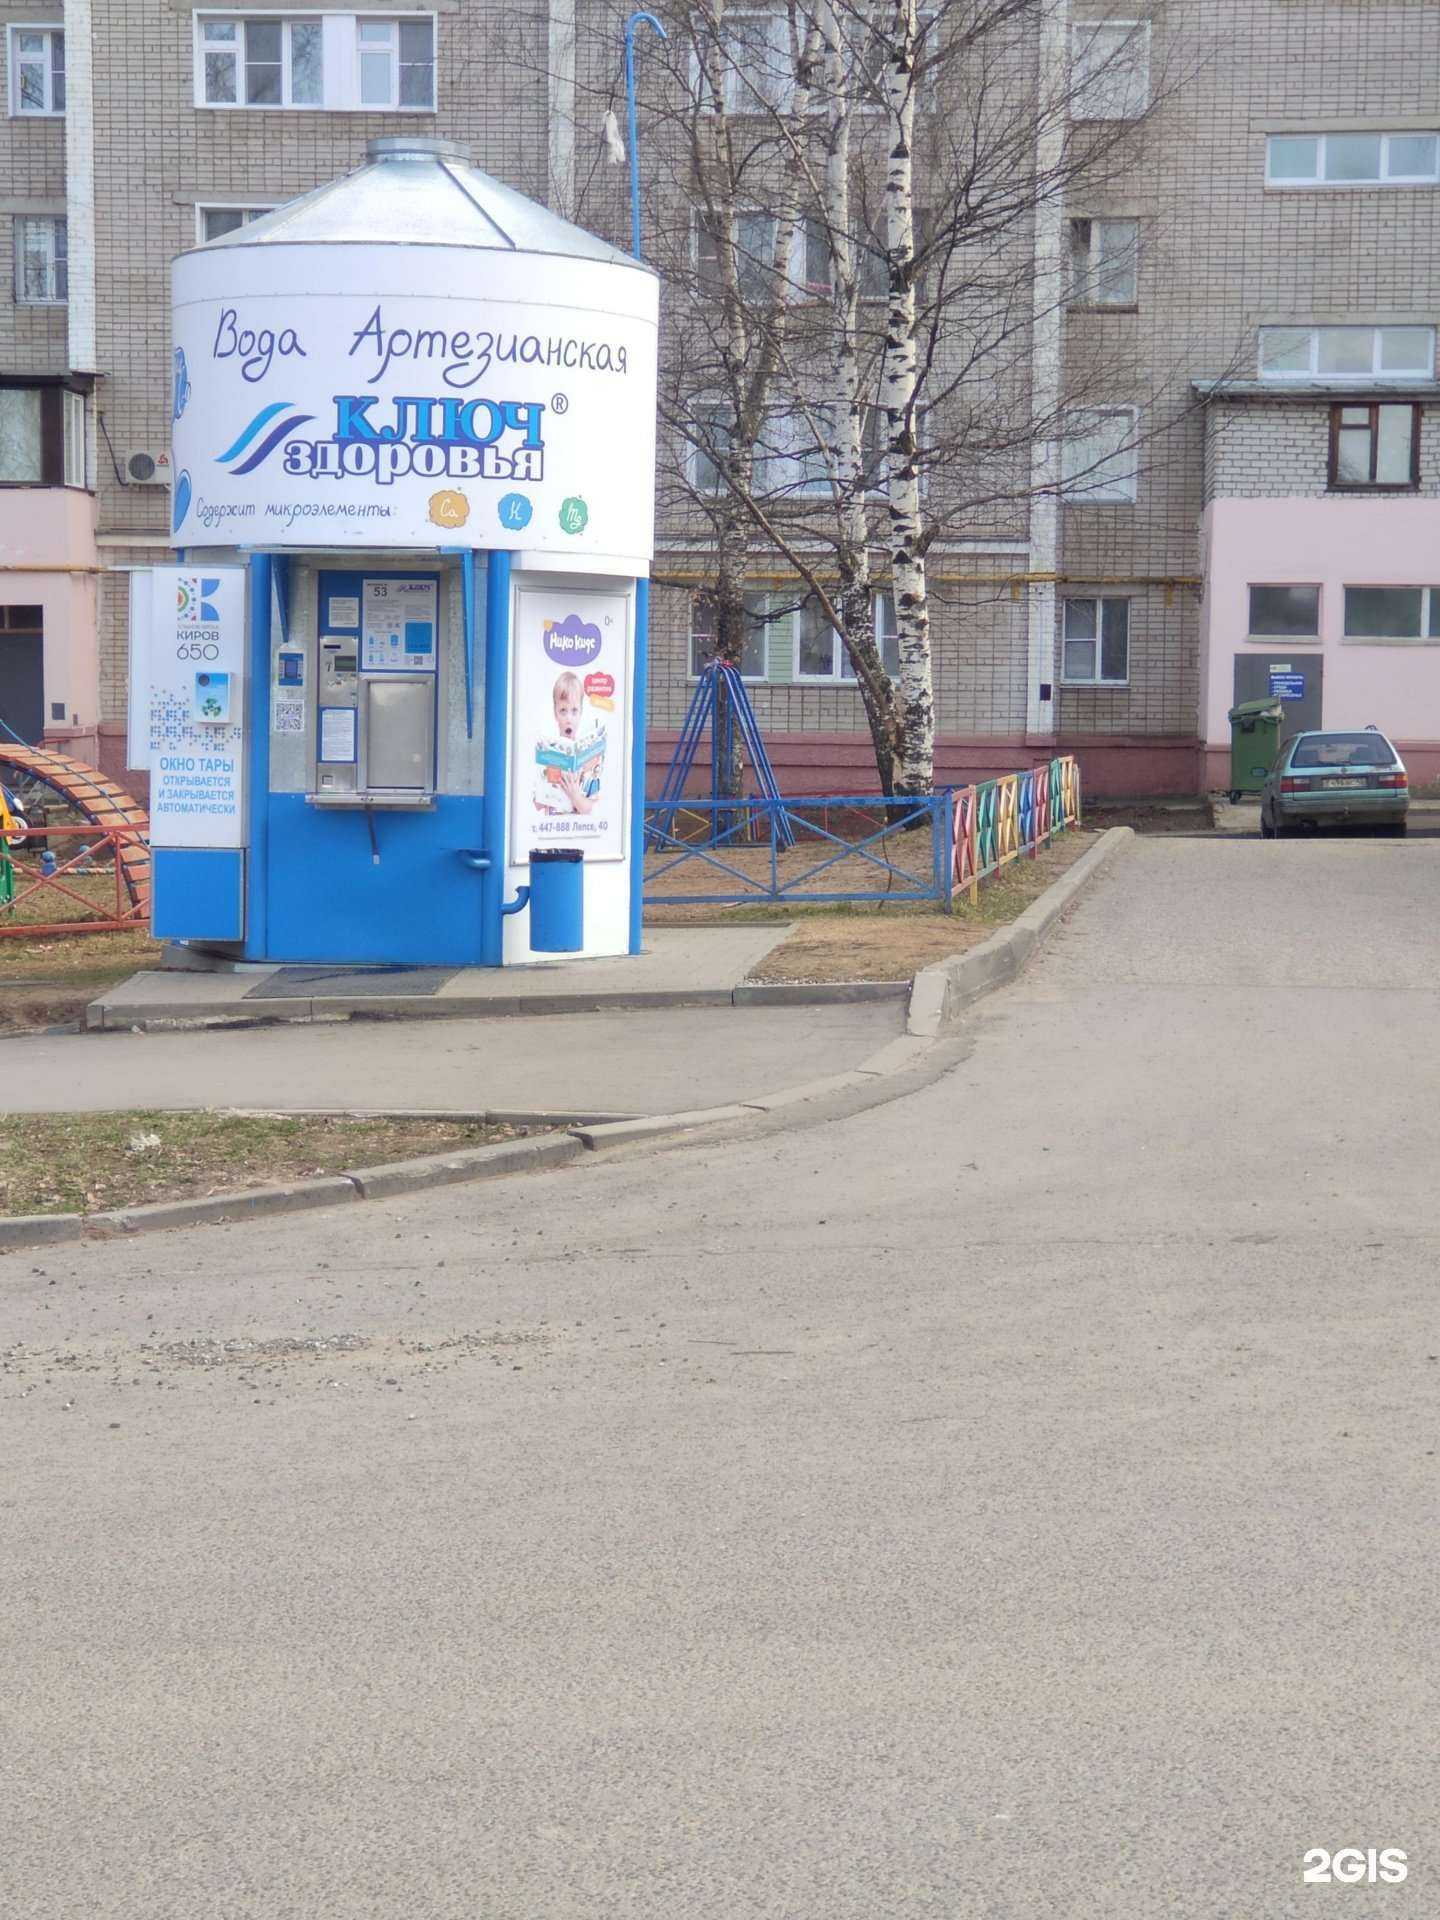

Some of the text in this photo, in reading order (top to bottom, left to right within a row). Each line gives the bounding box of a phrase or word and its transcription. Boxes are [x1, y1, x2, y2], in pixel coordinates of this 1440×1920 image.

[213, 304, 628, 389] Вода Артезианская
[283, 440, 545, 485] здоровья
[196, 496, 398, 528] Содержит микроэлементы:
[373, 586, 388, 597] 53
[176, 630, 220, 641] КИРОВ
[176, 643, 220, 661] 650
[160, 757, 234, 772] ОКНО ТАРЫ
[163, 775, 231, 787] ОТКРЫВАЕТСЯ
[158, 789, 235, 801] И ЗАКРЫВАЕТСЯ
[157, 803, 236, 815] АВТОМАТИЧЕСКИ
[539, 822, 570, 832] 447-888
[599, 821, 609, 831] 40
